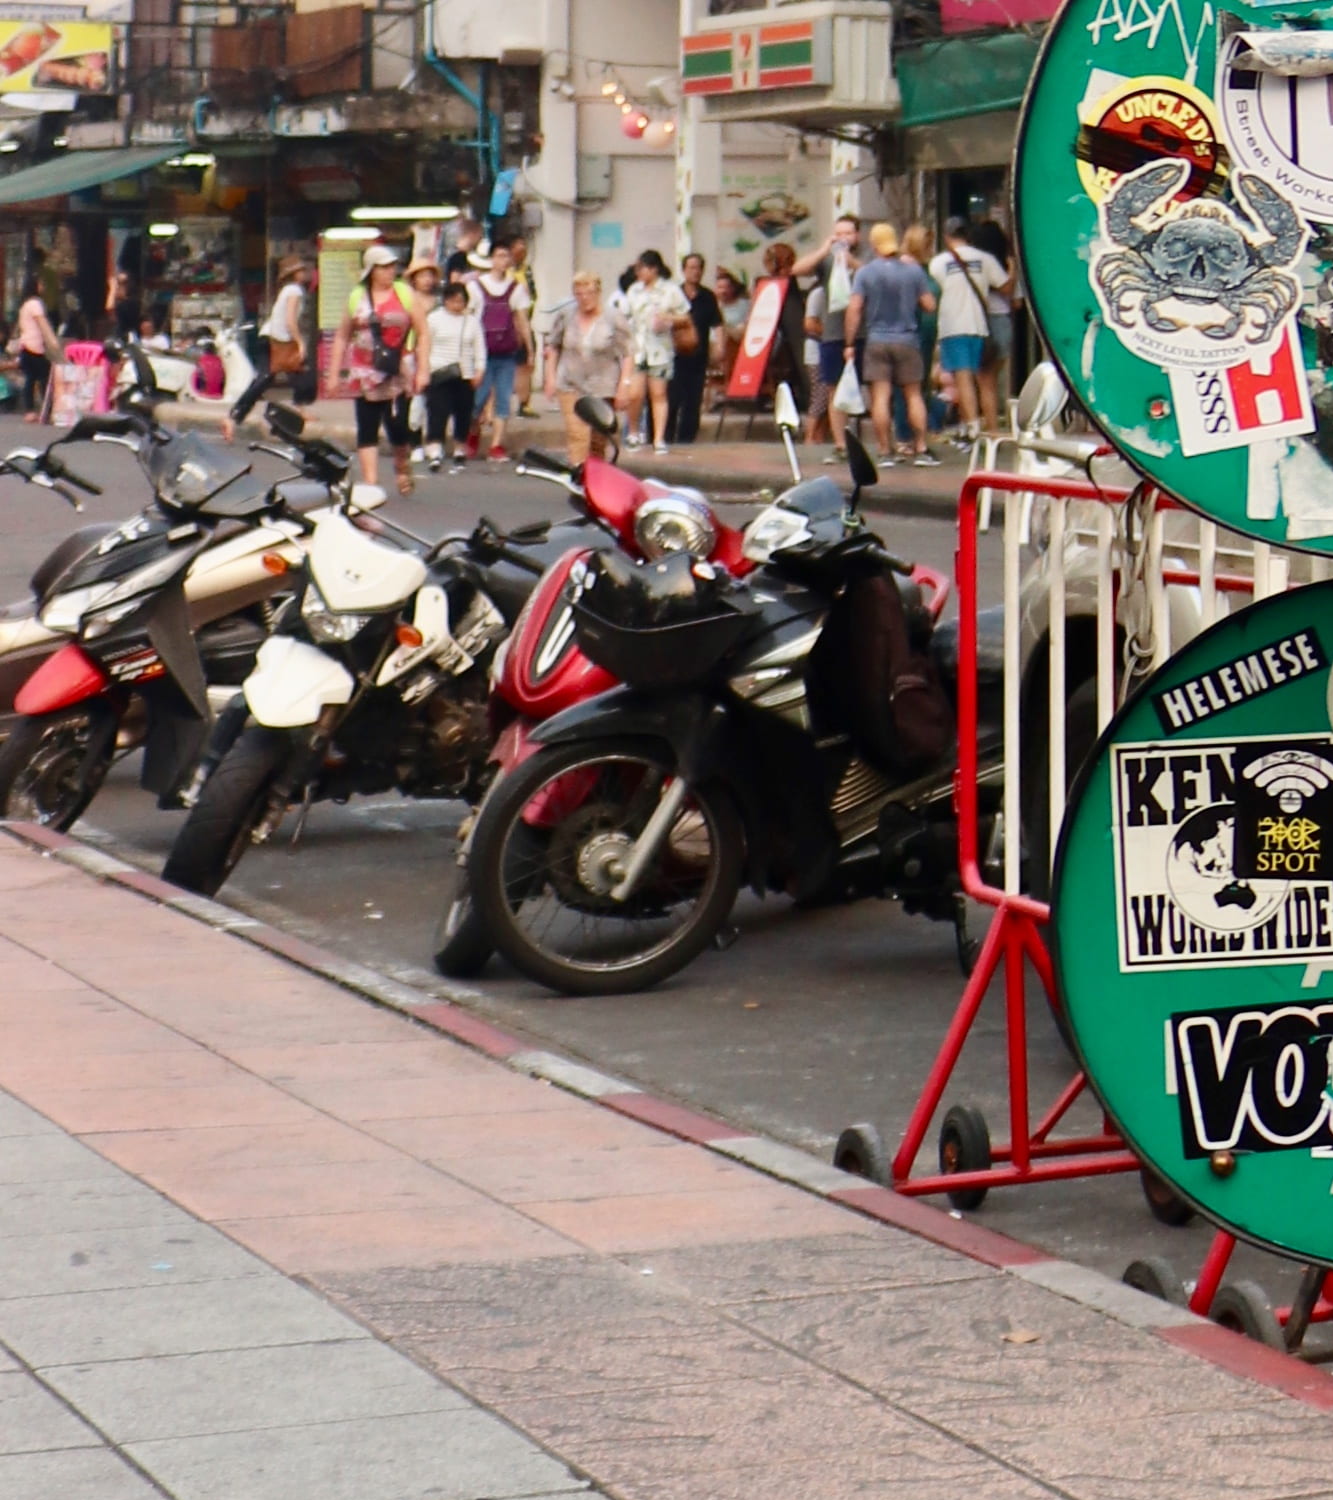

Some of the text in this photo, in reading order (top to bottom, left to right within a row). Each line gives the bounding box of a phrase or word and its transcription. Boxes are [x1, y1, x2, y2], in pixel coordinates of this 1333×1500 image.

[1115, 97, 1191, 132] UNCLE
[1236, 99, 1273, 175] Street
[1163, 631, 1319, 729] HELEMESE
[1256, 850, 1321, 873] SPOT
